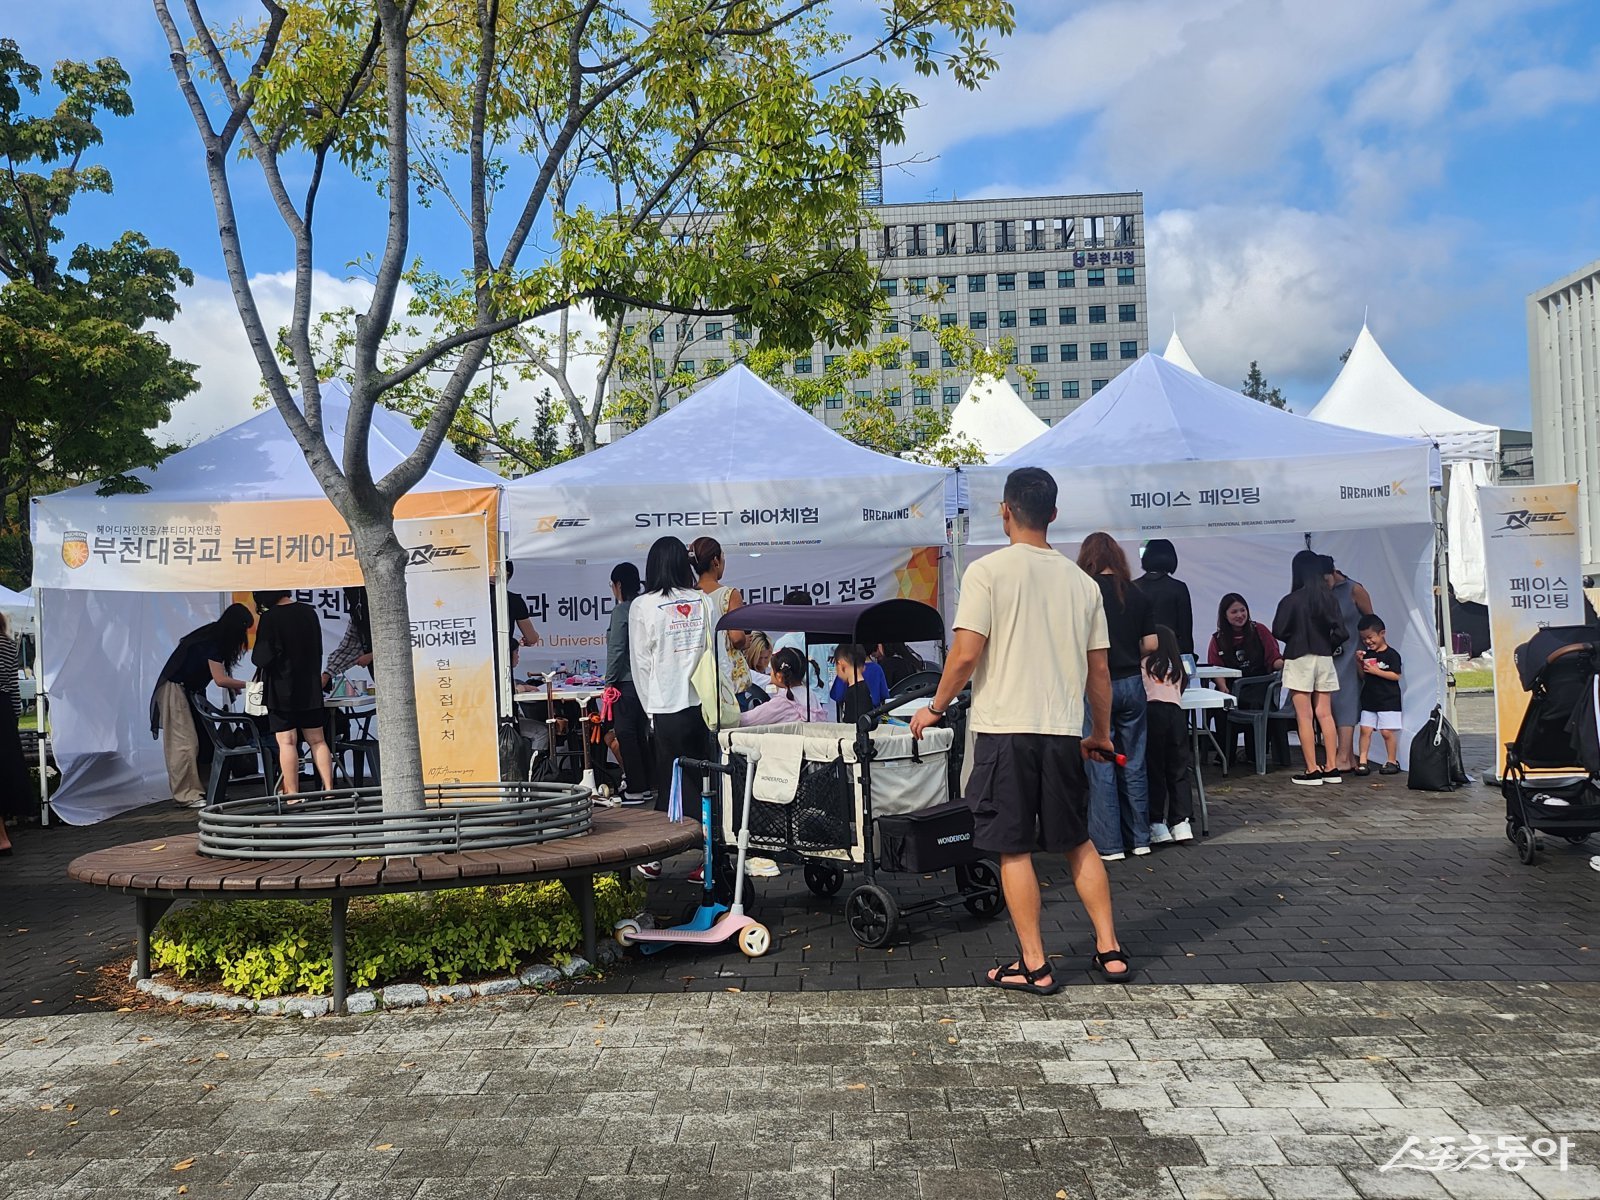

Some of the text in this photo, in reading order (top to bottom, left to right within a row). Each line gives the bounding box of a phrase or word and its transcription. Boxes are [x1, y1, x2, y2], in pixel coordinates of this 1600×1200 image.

[1130, 487, 1261, 509] 페이스 페인팅
[635, 506, 819, 528] STREET 헤어체험
[96, 525, 222, 536] 헤어디자인전공/뷰티디자인전공
[93, 533, 359, 566] 부천대학교 뷰티케어과
[838, 576, 877, 603] 전공
[1509, 577, 1568, 592] 페이스
[1511, 593, 1569, 609] 페인팅
[409, 617, 477, 632] STREET
[410, 630, 477, 649] 헤어체험
[436, 658, 456, 741] 현장접수처
[937, 832, 971, 846] WONDERFOLD
